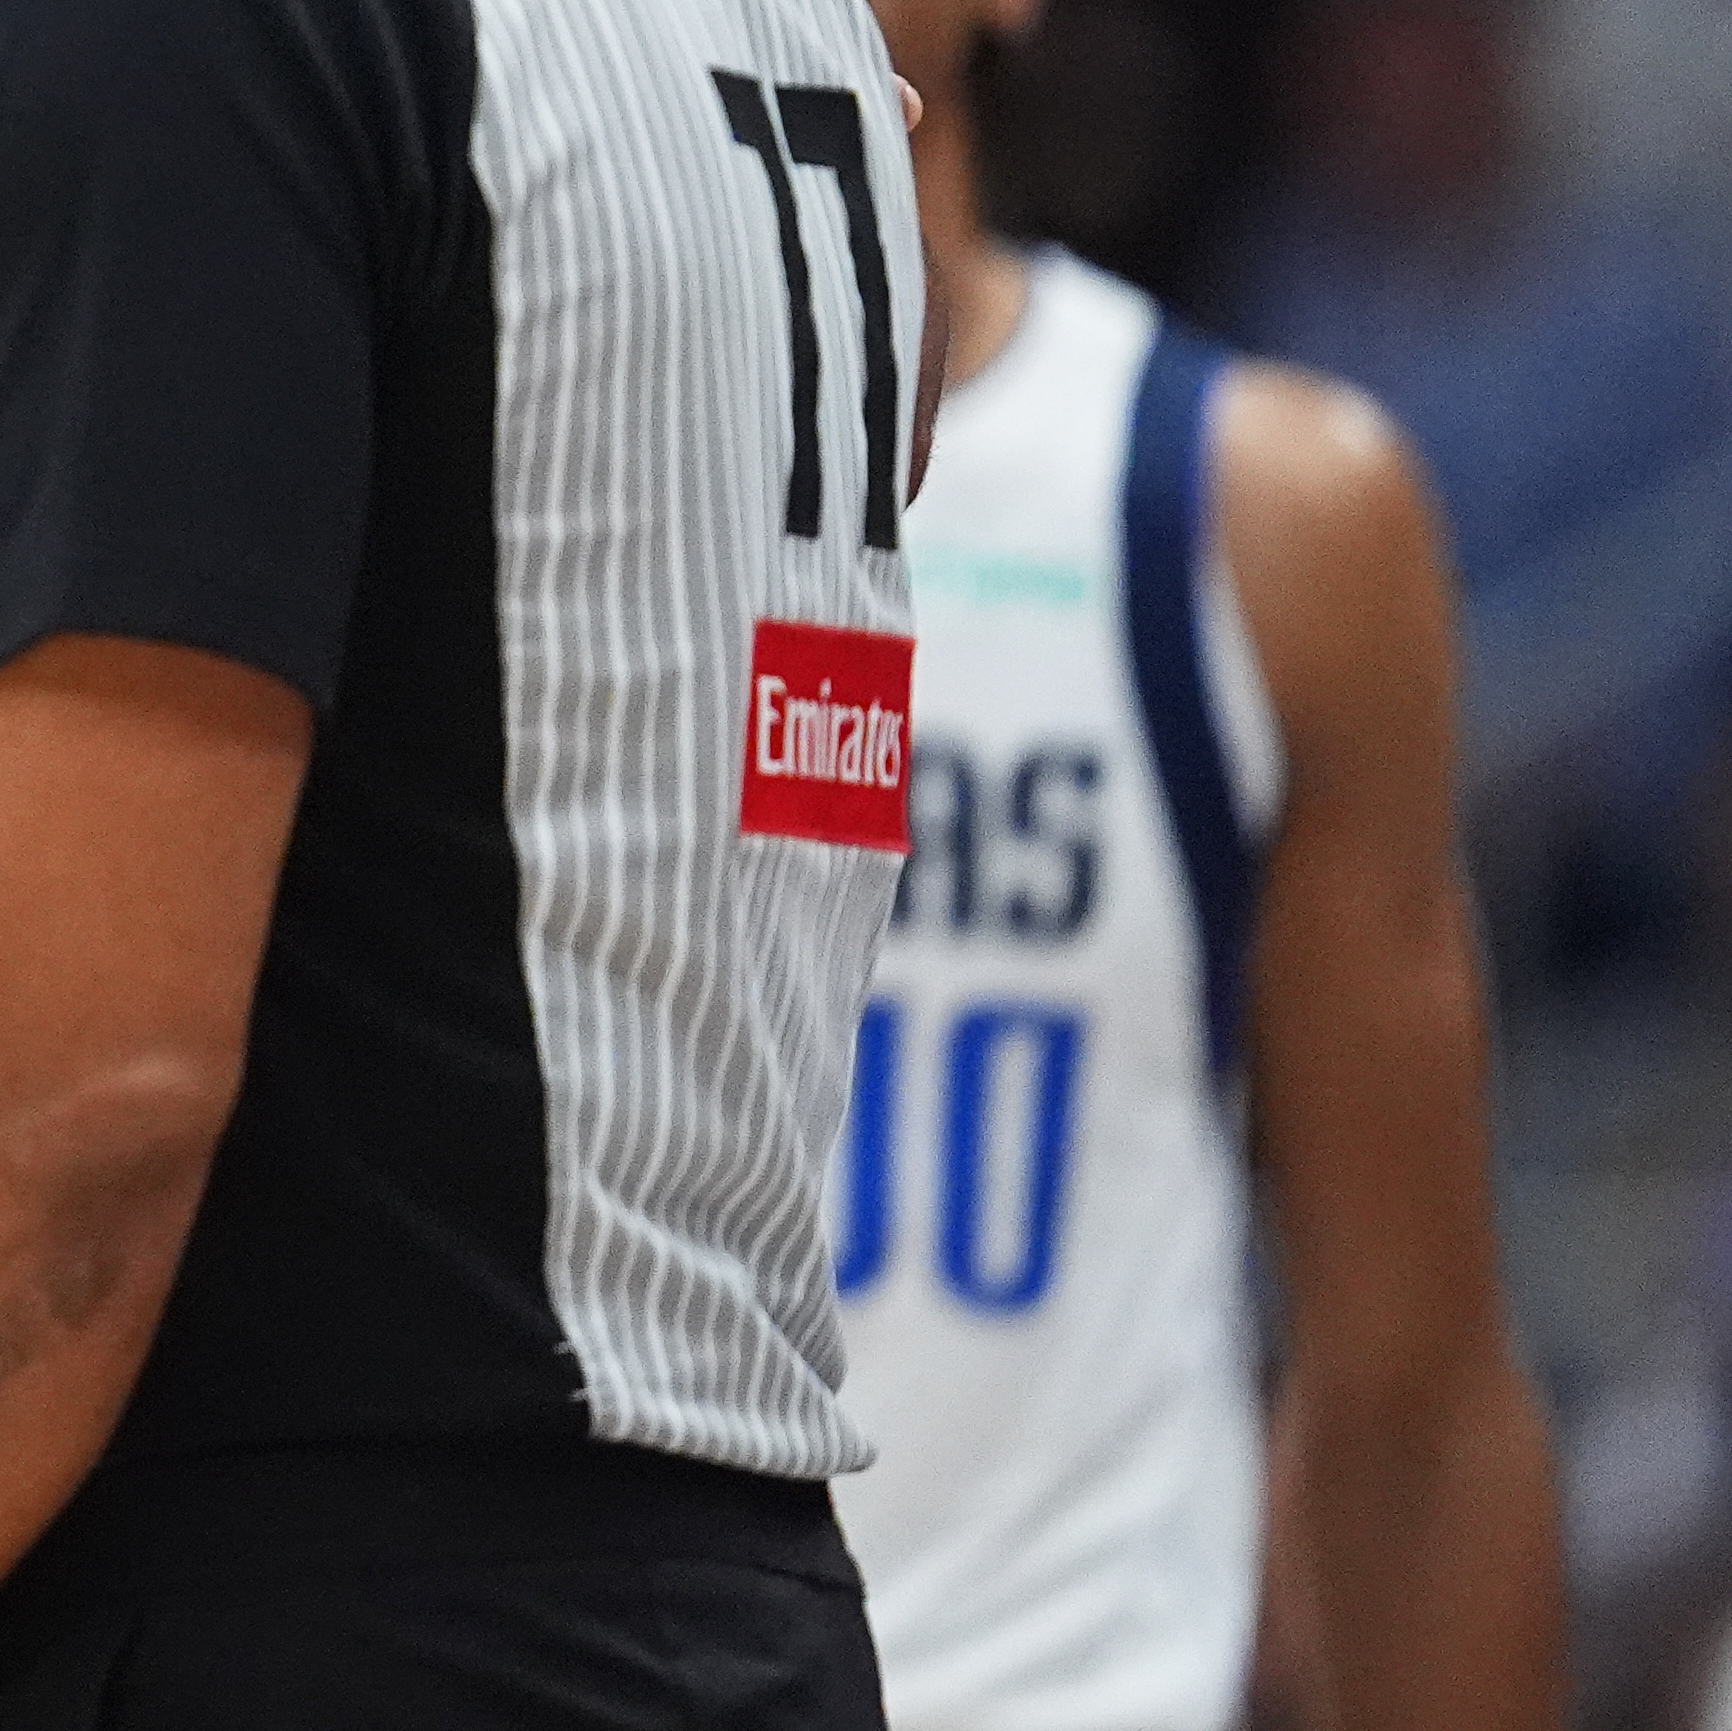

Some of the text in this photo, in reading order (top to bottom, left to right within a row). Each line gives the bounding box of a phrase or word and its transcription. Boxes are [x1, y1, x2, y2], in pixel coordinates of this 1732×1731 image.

[711, 66, 898, 550] 17
[756, 674, 905, 789] Emirates
[890, 733, 1105, 940] AS
